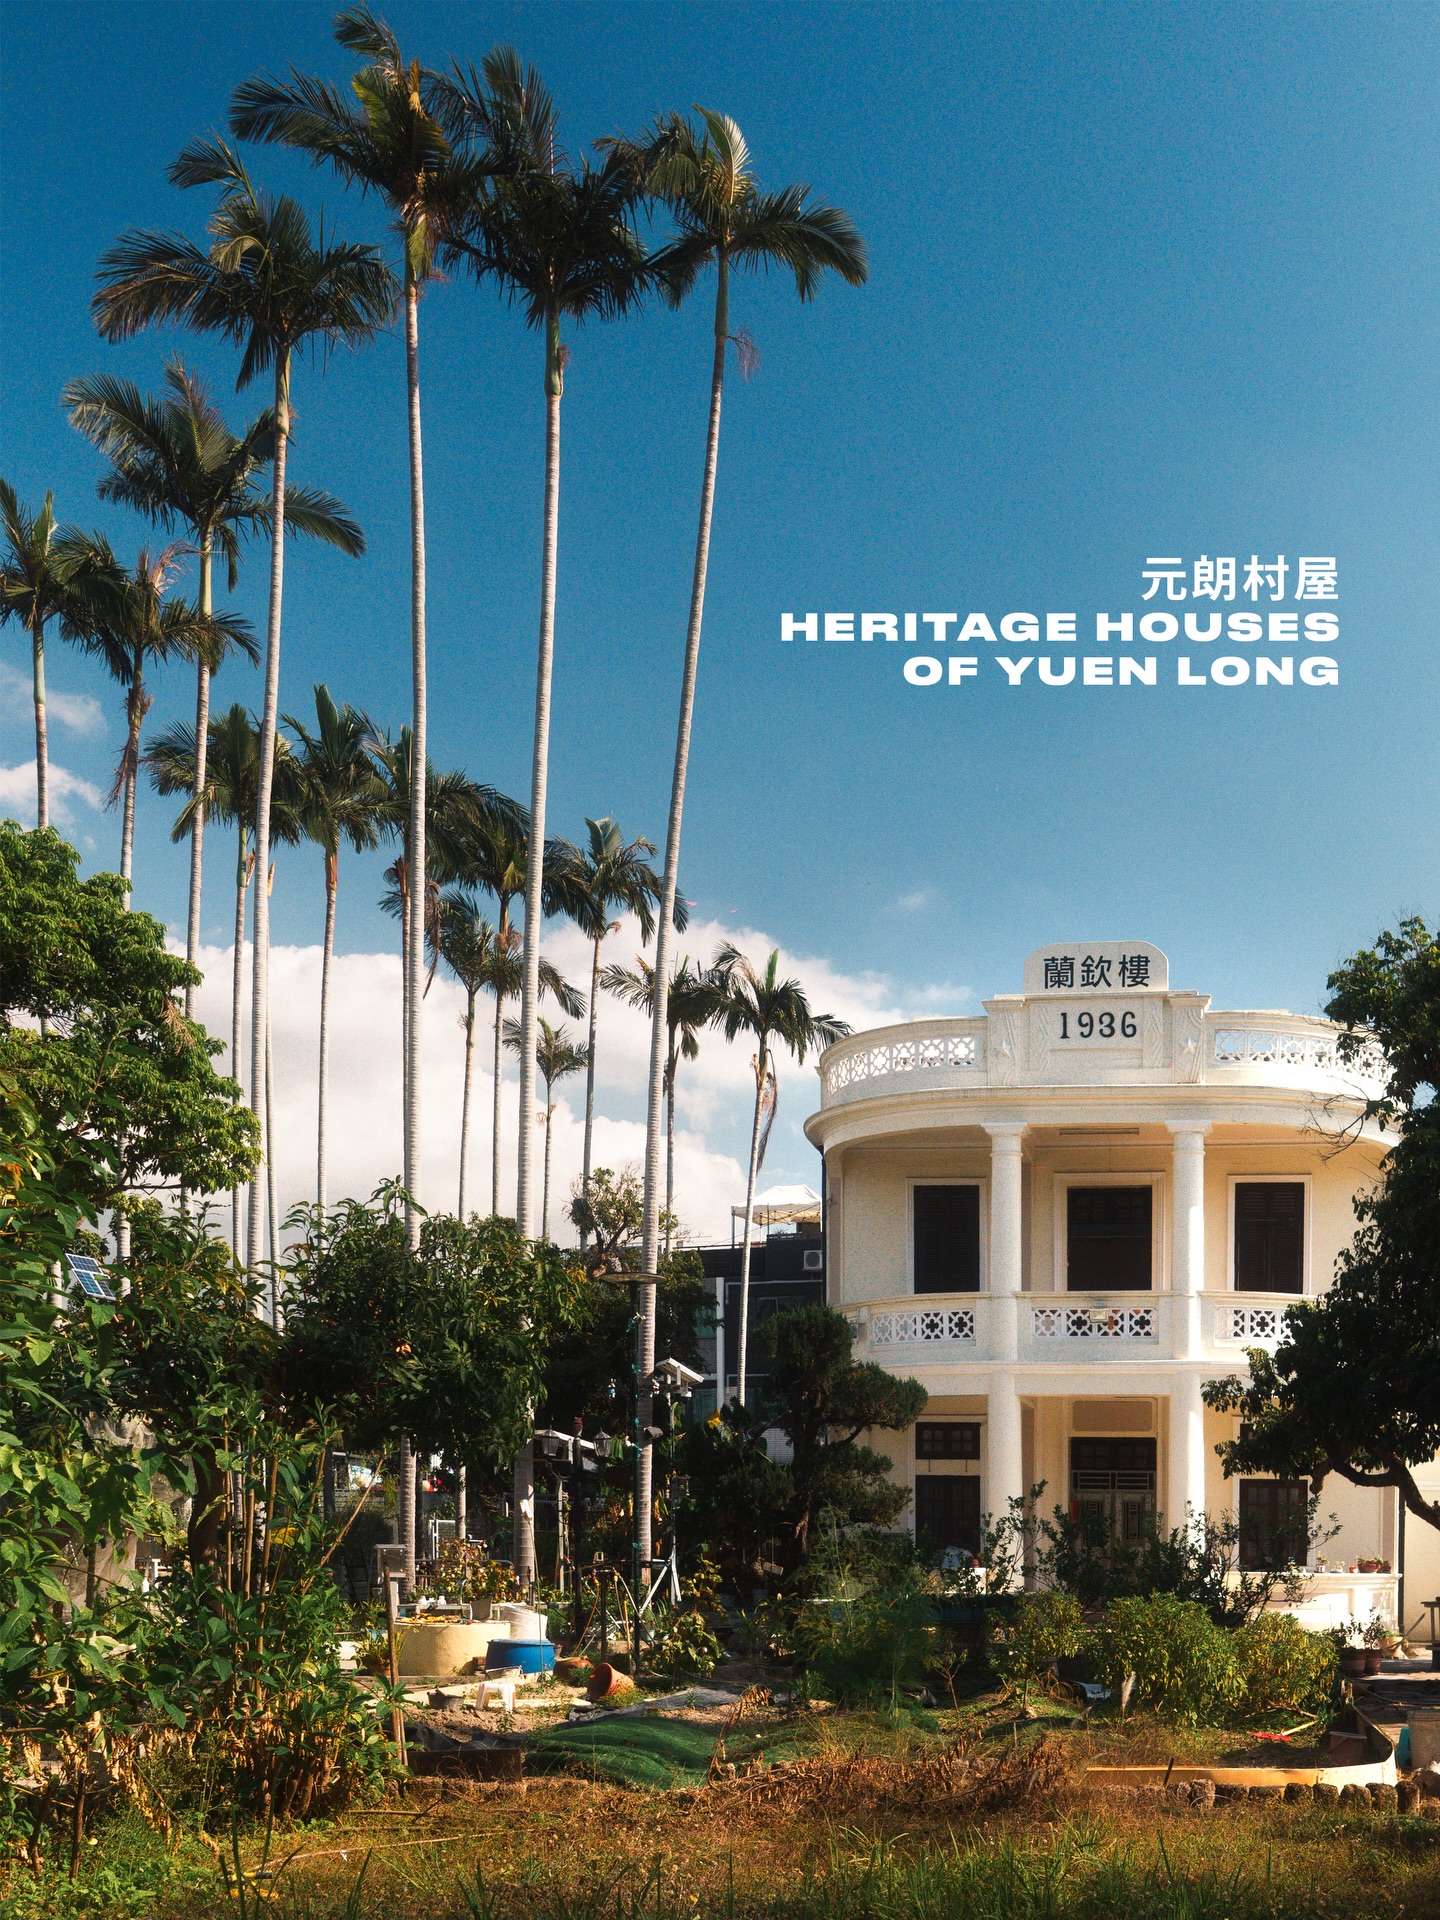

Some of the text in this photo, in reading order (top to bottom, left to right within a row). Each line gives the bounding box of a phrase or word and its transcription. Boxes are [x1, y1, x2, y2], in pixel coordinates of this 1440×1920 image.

[1043, 954, 1151, 990] 蘭欽樓
[1059, 1010, 1138, 1040] 1936
